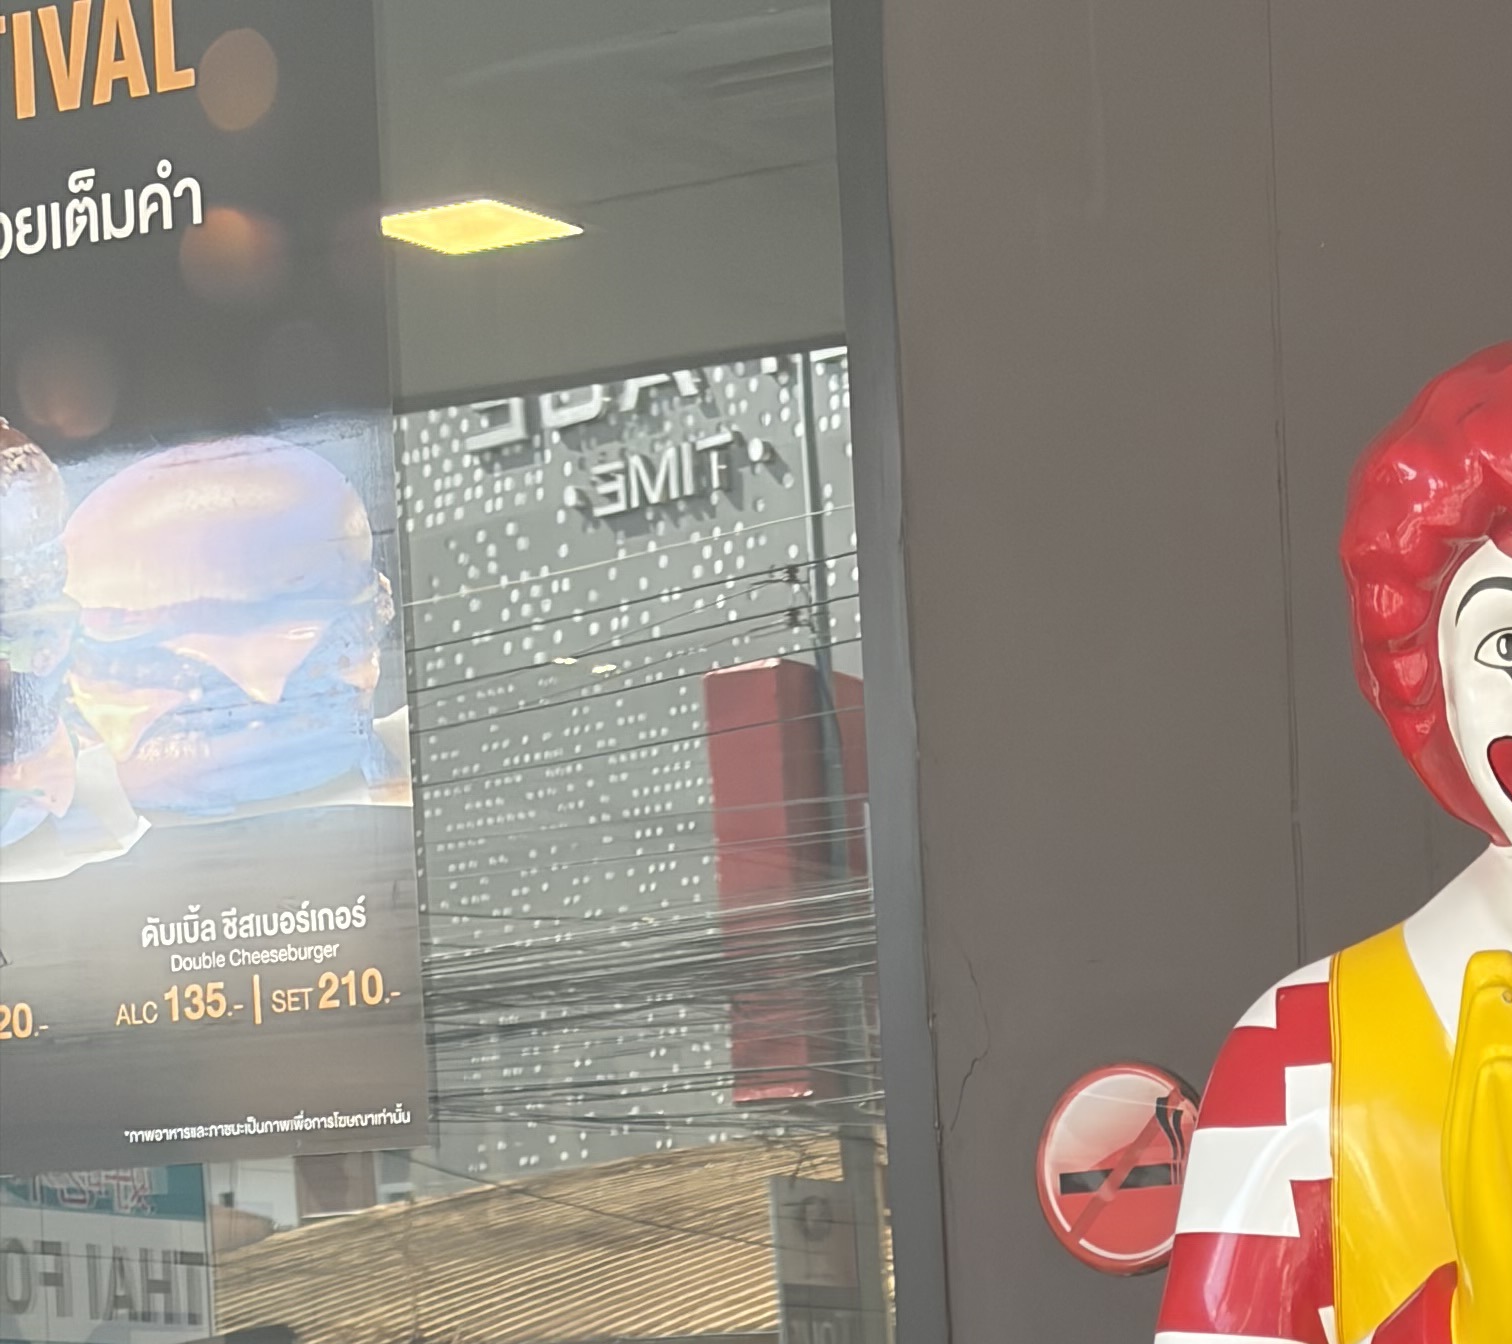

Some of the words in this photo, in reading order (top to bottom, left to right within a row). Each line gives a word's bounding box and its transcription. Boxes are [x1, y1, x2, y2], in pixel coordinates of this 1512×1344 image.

[0, 0, 196, 120] IVAL
[140, 904, 217, 949] ดับเบิ้ล
[221, 895, 367, 941] ชีสเบอร์เกอร์
[170, 947, 226, 973] Double
[229, 942, 340, 967] Cheeseburger
[115, 1000, 158, 1027] ALC
[163, 981, 244, 1023] 135.-
[270, 987, 314, 1014] SET
[317, 967, 401, 1012] 210.-
